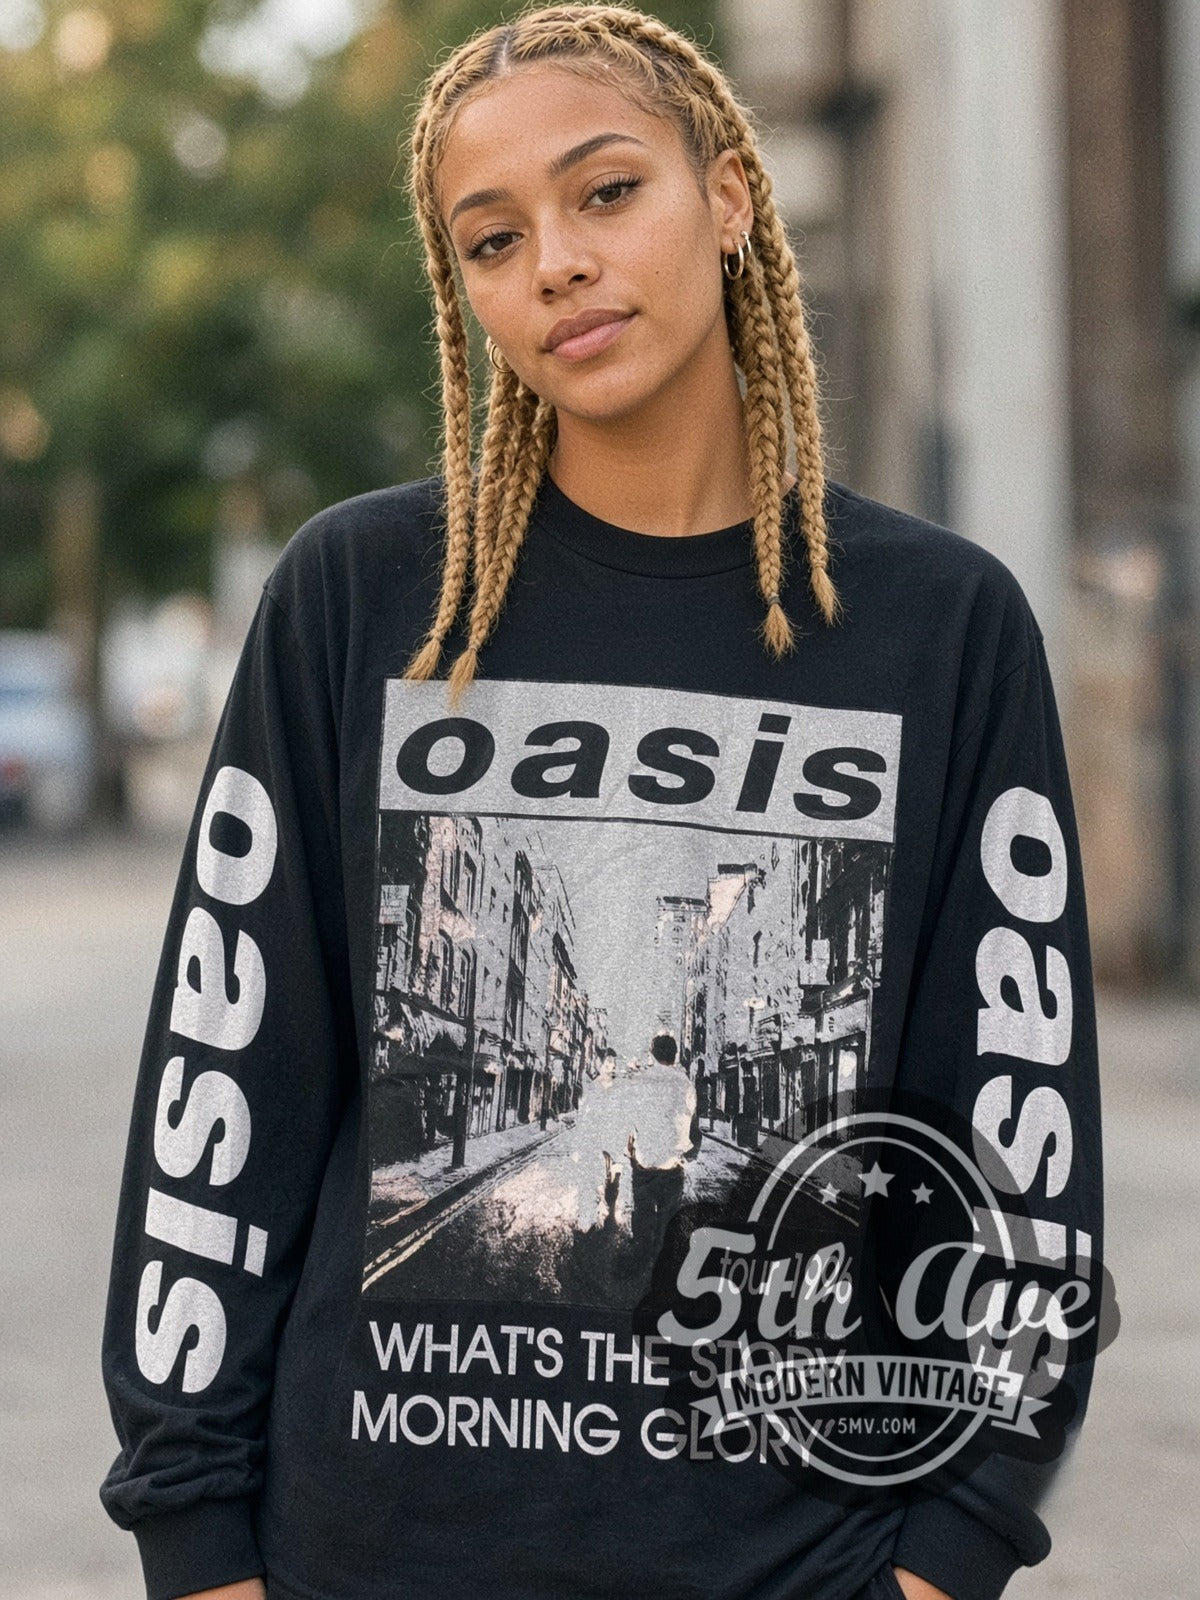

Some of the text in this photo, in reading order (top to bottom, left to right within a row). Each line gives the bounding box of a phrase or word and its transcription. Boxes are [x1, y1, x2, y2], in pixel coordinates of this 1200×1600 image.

[396, 713, 887, 820] oasis
[135, 766, 277, 1393] oasis
[966, 787, 1092, 1398] oasis
[716, 1247, 853, 1305] tour 1996
[369, 1321, 847, 1396] WHAT'S THE STORY
[351, 1390, 620, 1456] MORNING
